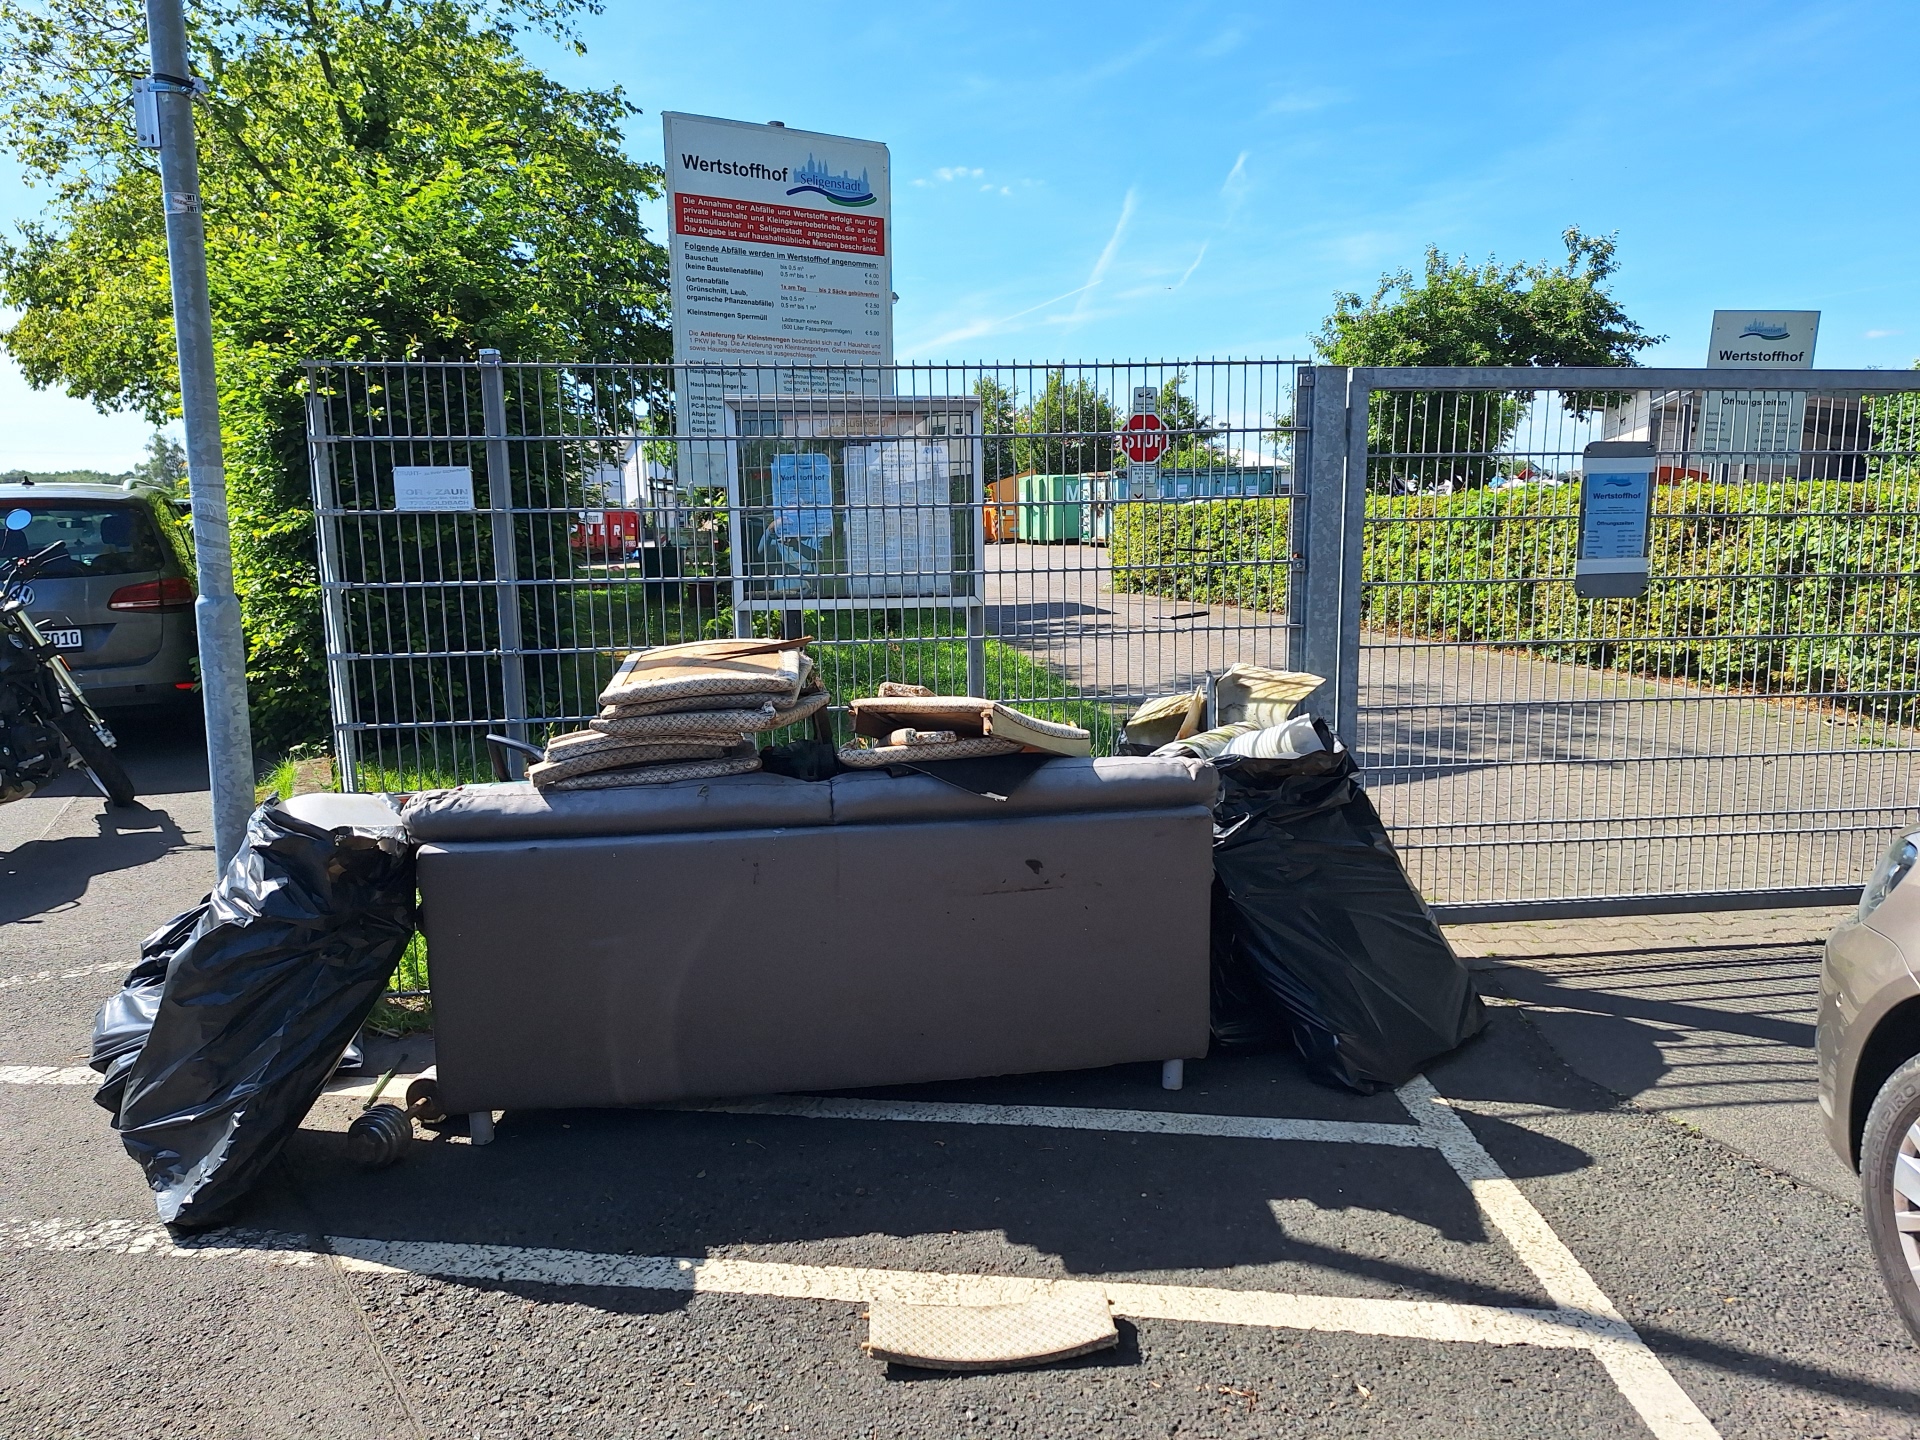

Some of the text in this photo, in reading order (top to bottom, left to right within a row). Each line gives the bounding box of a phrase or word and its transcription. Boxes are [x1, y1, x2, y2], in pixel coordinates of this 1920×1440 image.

[682, 154, 861, 192] Wertstoffhof Seligenstadt
[683, 197, 695, 205] Die
[698, 198, 732, 210] Annahme
[736, 203, 748, 211] der
[750, 204, 774, 214] Abfälle
[778, 208, 790, 216] und
[793, 209, 828, 221] Wertstoffe
[830, 214, 852, 225] erfolgt
[868, 218, 878, 227] für
[684, 207, 708, 217] private
[712, 209, 748, 220] Haushalte
[751, 214, 764, 222] und
[767, 216, 843, 232] Kleingewerbebetriebe,
[845, 225, 855, 233] die
[868, 227, 877, 235] die
[684, 215, 742, 229] Hausmüllabfuhr
[759, 224, 802, 236] Seligenstadt
[807, 230, 857, 242] angeschlossen
[684, 224, 696, 232] Die
[698, 226, 726, 237] Abgabe
[739, 231, 750, 239] auf
[752, 232, 811, 245] haushaltsübliche
[812, 239, 838, 250] Mengen
[840, 242, 878, 253] beschränkt.
[685, 242, 719, 252] Folgende
[722, 246, 746, 255] Abfälle
[749, 250, 774, 258] werden
[787, 253, 830, 264] Wertstoffhof
[832, 259, 878, 269] angenommen:
[685, 254, 718, 262] Bauschutt
[685, 263, 764, 276] (keine Baustellenabfälle)
[686, 276, 729, 285] Gartenabfälle
[686, 285, 728, 295] (Grünschnitt,
[724, 297, 774, 308] Pflanzenabfälle)
[687, 308, 767, 320] Kleinstmengen Sperrmüll
[805, 326, 852, 335] Fassungsvermögen)
[700, 331, 735, 340] Anlieferung
[747, 334, 790, 343] Kleinstmengen
[707, 346, 764, 355] Hausmeisterservices
[742, 341, 772, 349] Anlieferung
[832, 346, 881, 355] Gewerbetreibenden
[1719, 350, 1804, 362] Wertstoffhof
